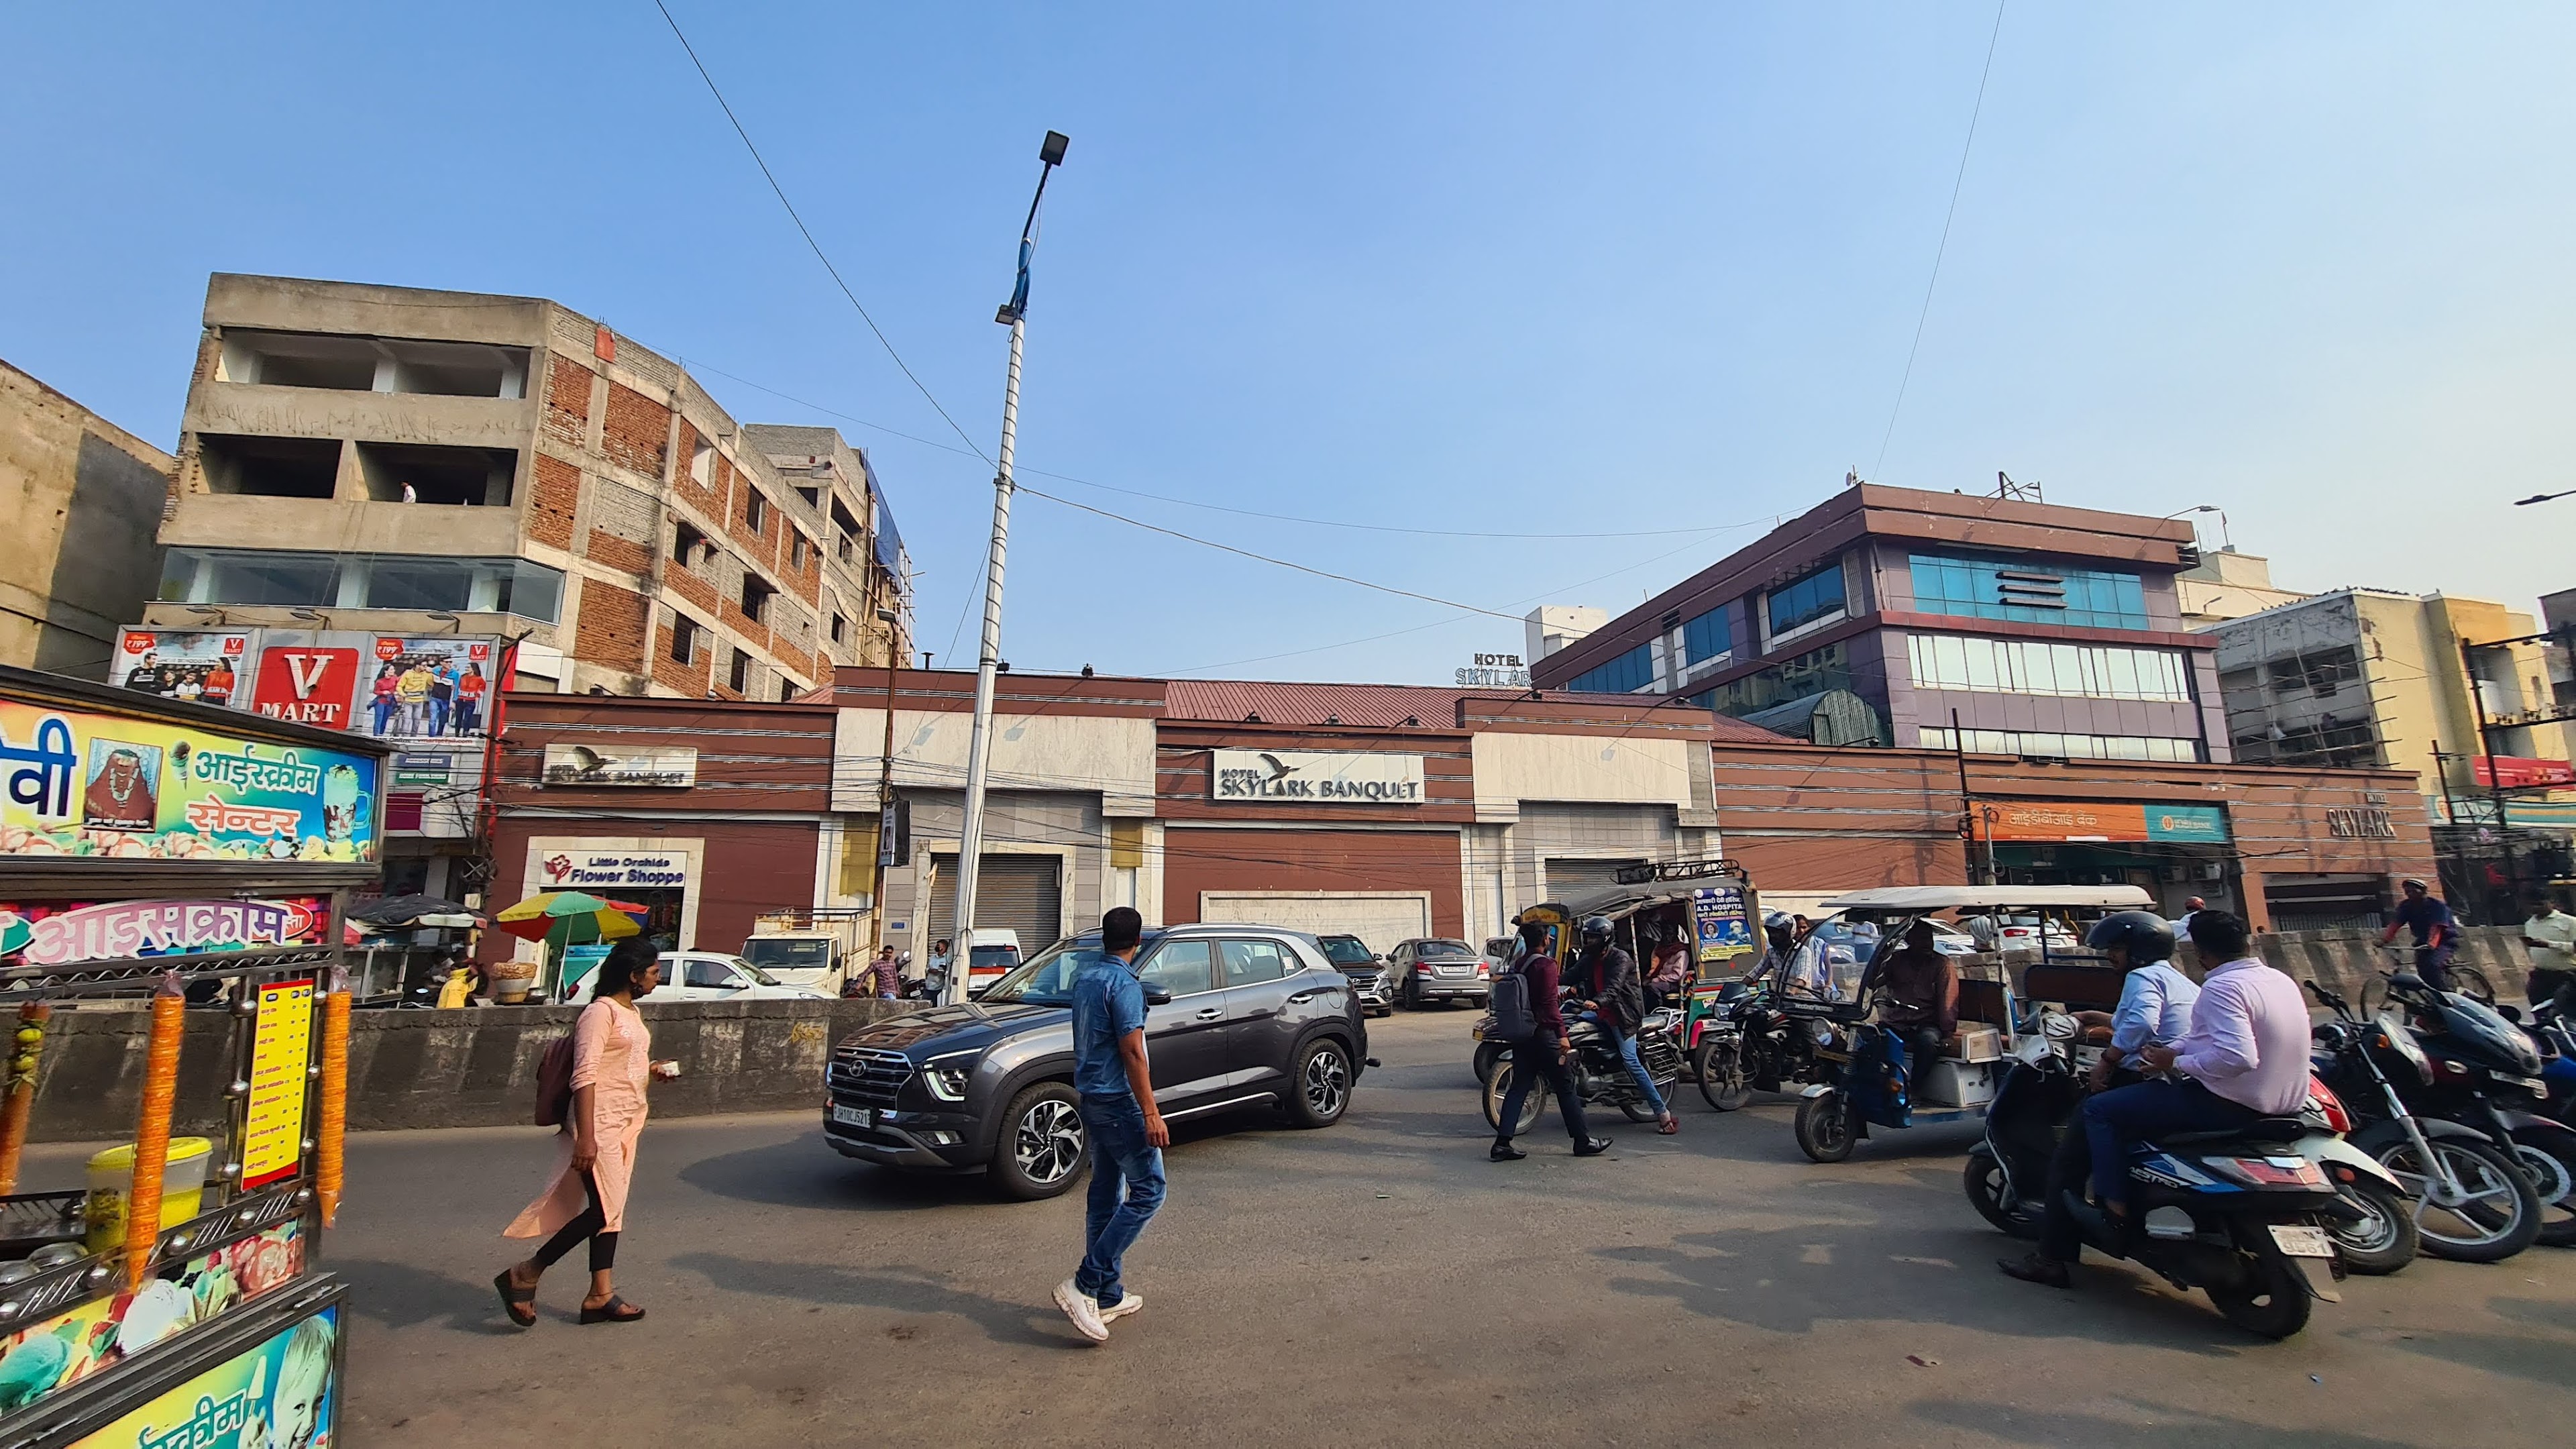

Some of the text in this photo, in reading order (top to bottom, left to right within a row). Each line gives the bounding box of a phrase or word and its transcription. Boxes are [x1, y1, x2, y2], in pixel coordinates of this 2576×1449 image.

[1474, 653, 1523, 667] HOTEL
[284, 653, 335, 700] V
[1455, 667, 1531, 686] SKYLAR
[260, 702, 341, 723] MART
[0, 718, 77, 816] वी
[1221, 769, 1260, 779] HOTEL
[1221, 778, 1419, 800] SKYLARK BANQUET
[2328, 808, 2397, 837] SKYLARK
[588, 857, 670, 867] Little Orchids
[570, 869, 684, 885] Flower Shoppe
[1712, 903, 1744, 911] HOSPITA
[2129, 1166, 2178, 1189] AESTRO
